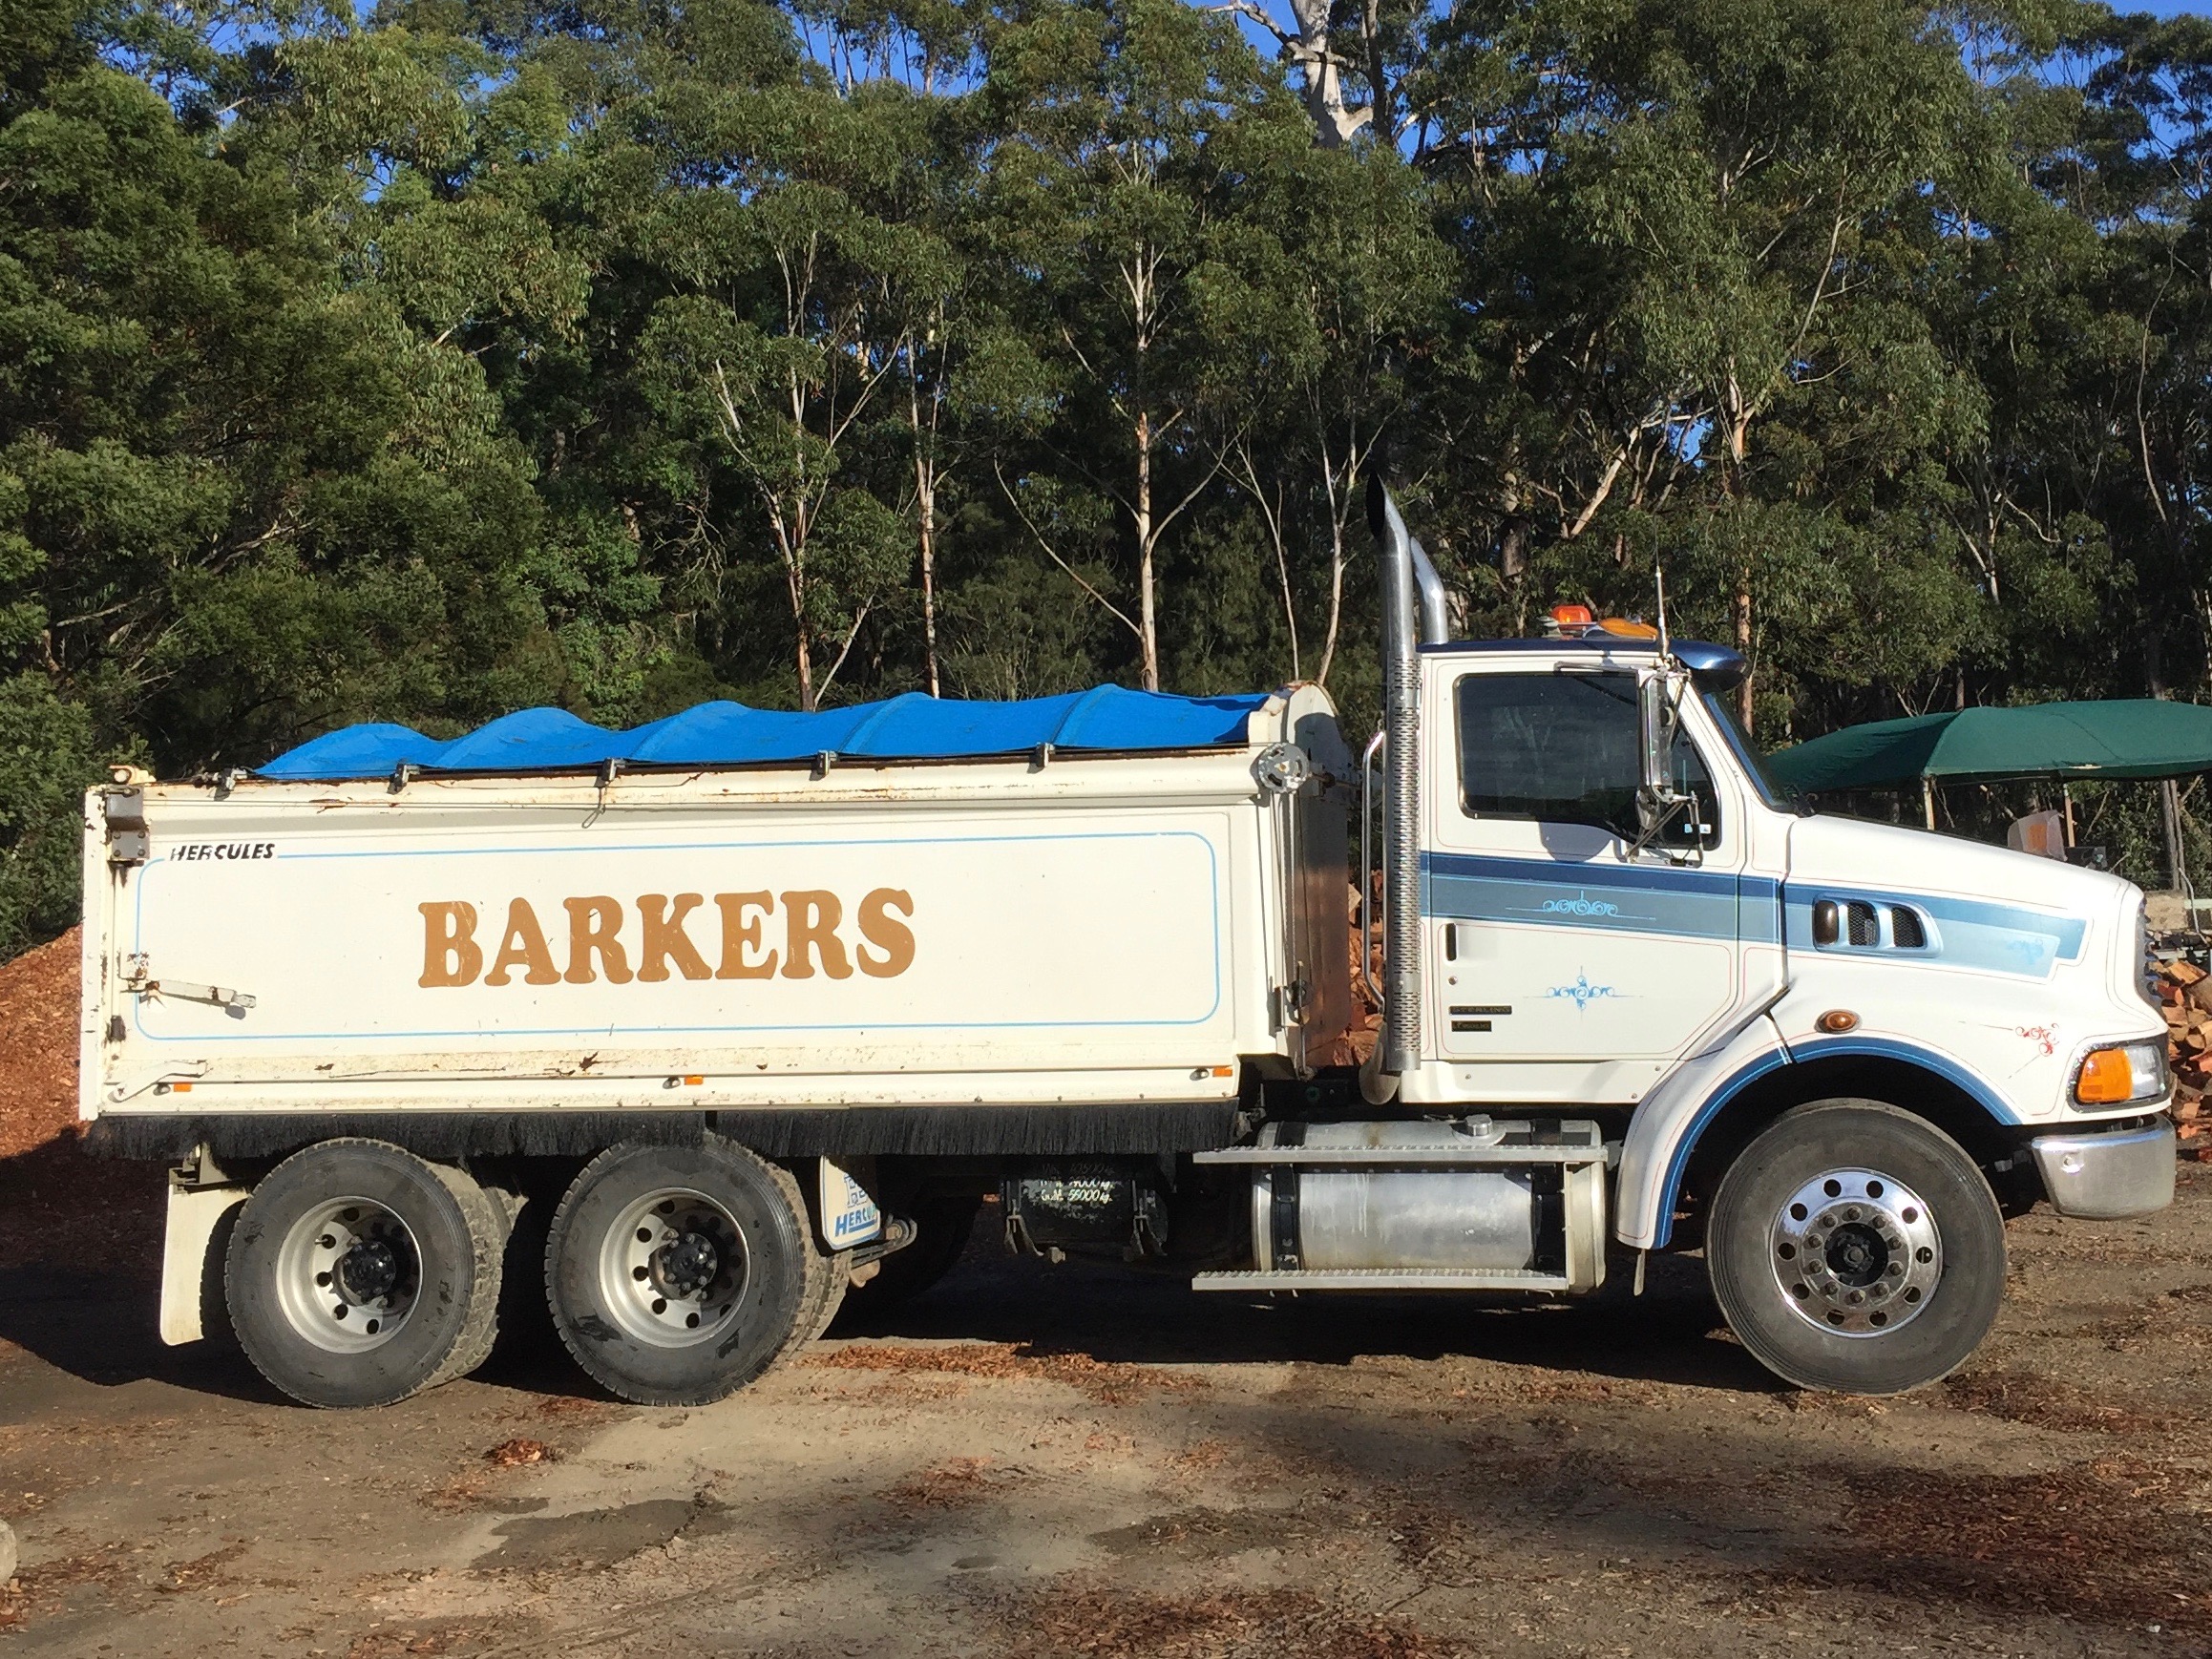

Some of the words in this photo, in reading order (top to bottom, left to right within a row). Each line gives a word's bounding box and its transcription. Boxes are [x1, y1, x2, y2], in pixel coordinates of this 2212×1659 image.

[170, 843, 275, 861] HERCULES
[418, 888, 916, 988] BARKERS
[1068, 1189, 1100, 1201] 55000
